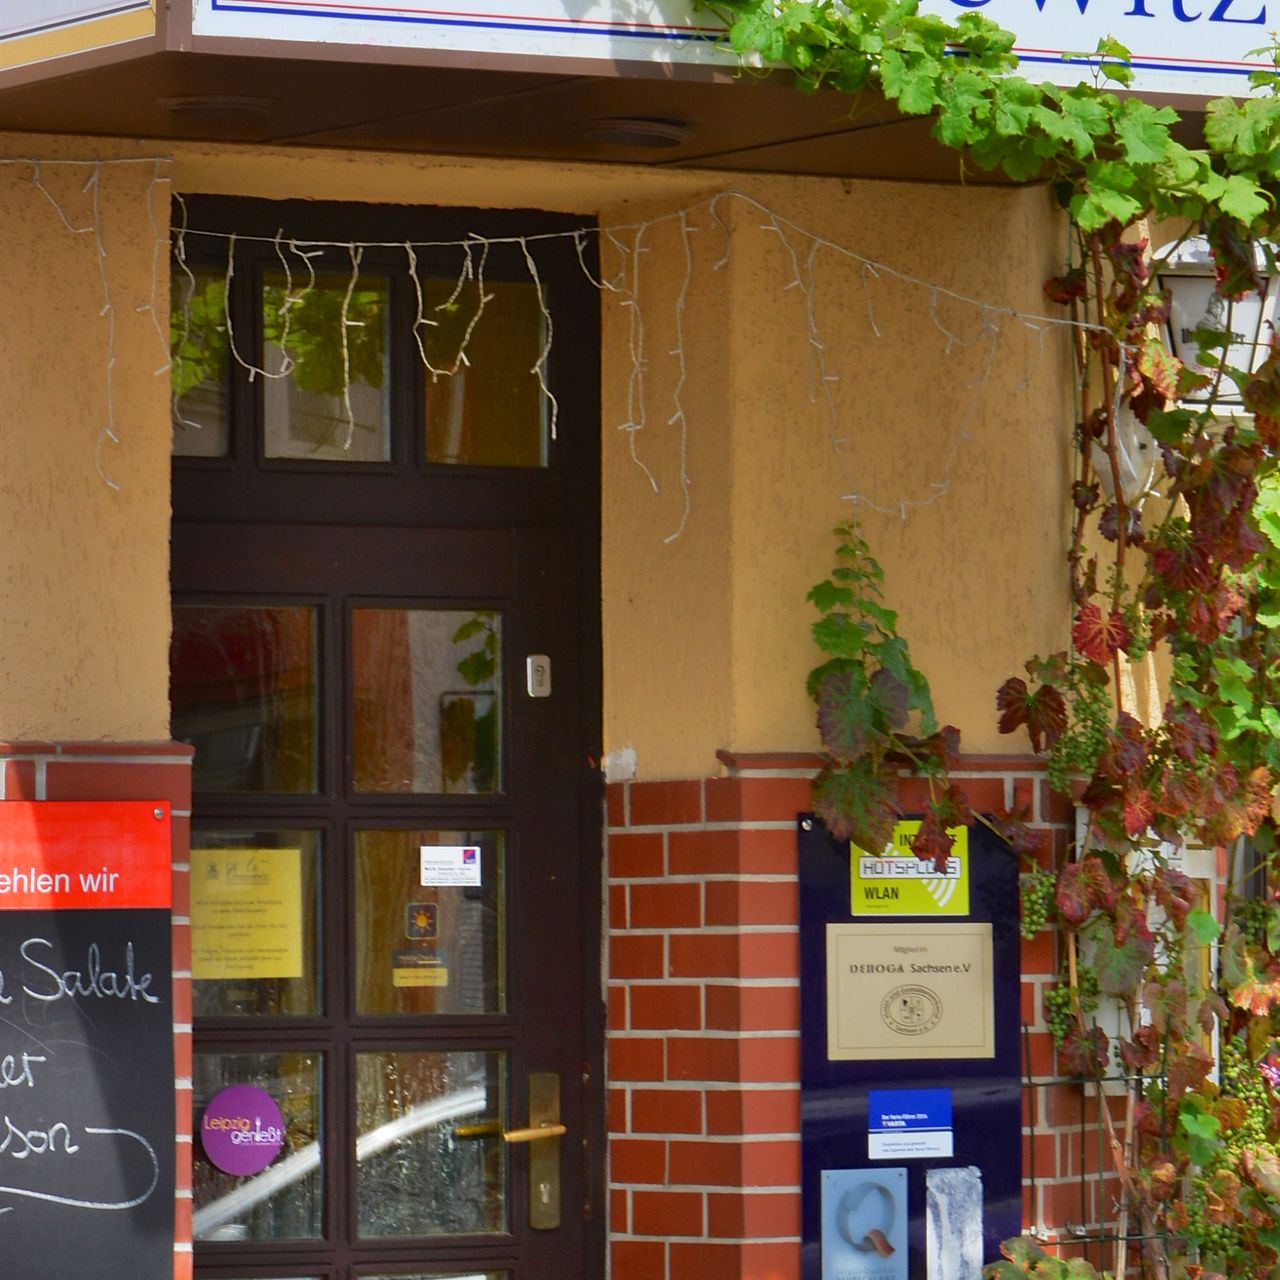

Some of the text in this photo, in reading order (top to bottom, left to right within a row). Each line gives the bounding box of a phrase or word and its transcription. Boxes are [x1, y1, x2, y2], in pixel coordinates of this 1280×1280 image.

[862, 860, 957, 875] HOTSPLOS
[0, 866, 120, 893] ehlen wir
[864, 887, 899, 899] WLAN
[20, 938, 160, 1003] Salate
[849, 964, 905, 974] DEHOGA
[911, 963, 952, 974] Sachsen
[204, 1114, 251, 1133] Leipzig
